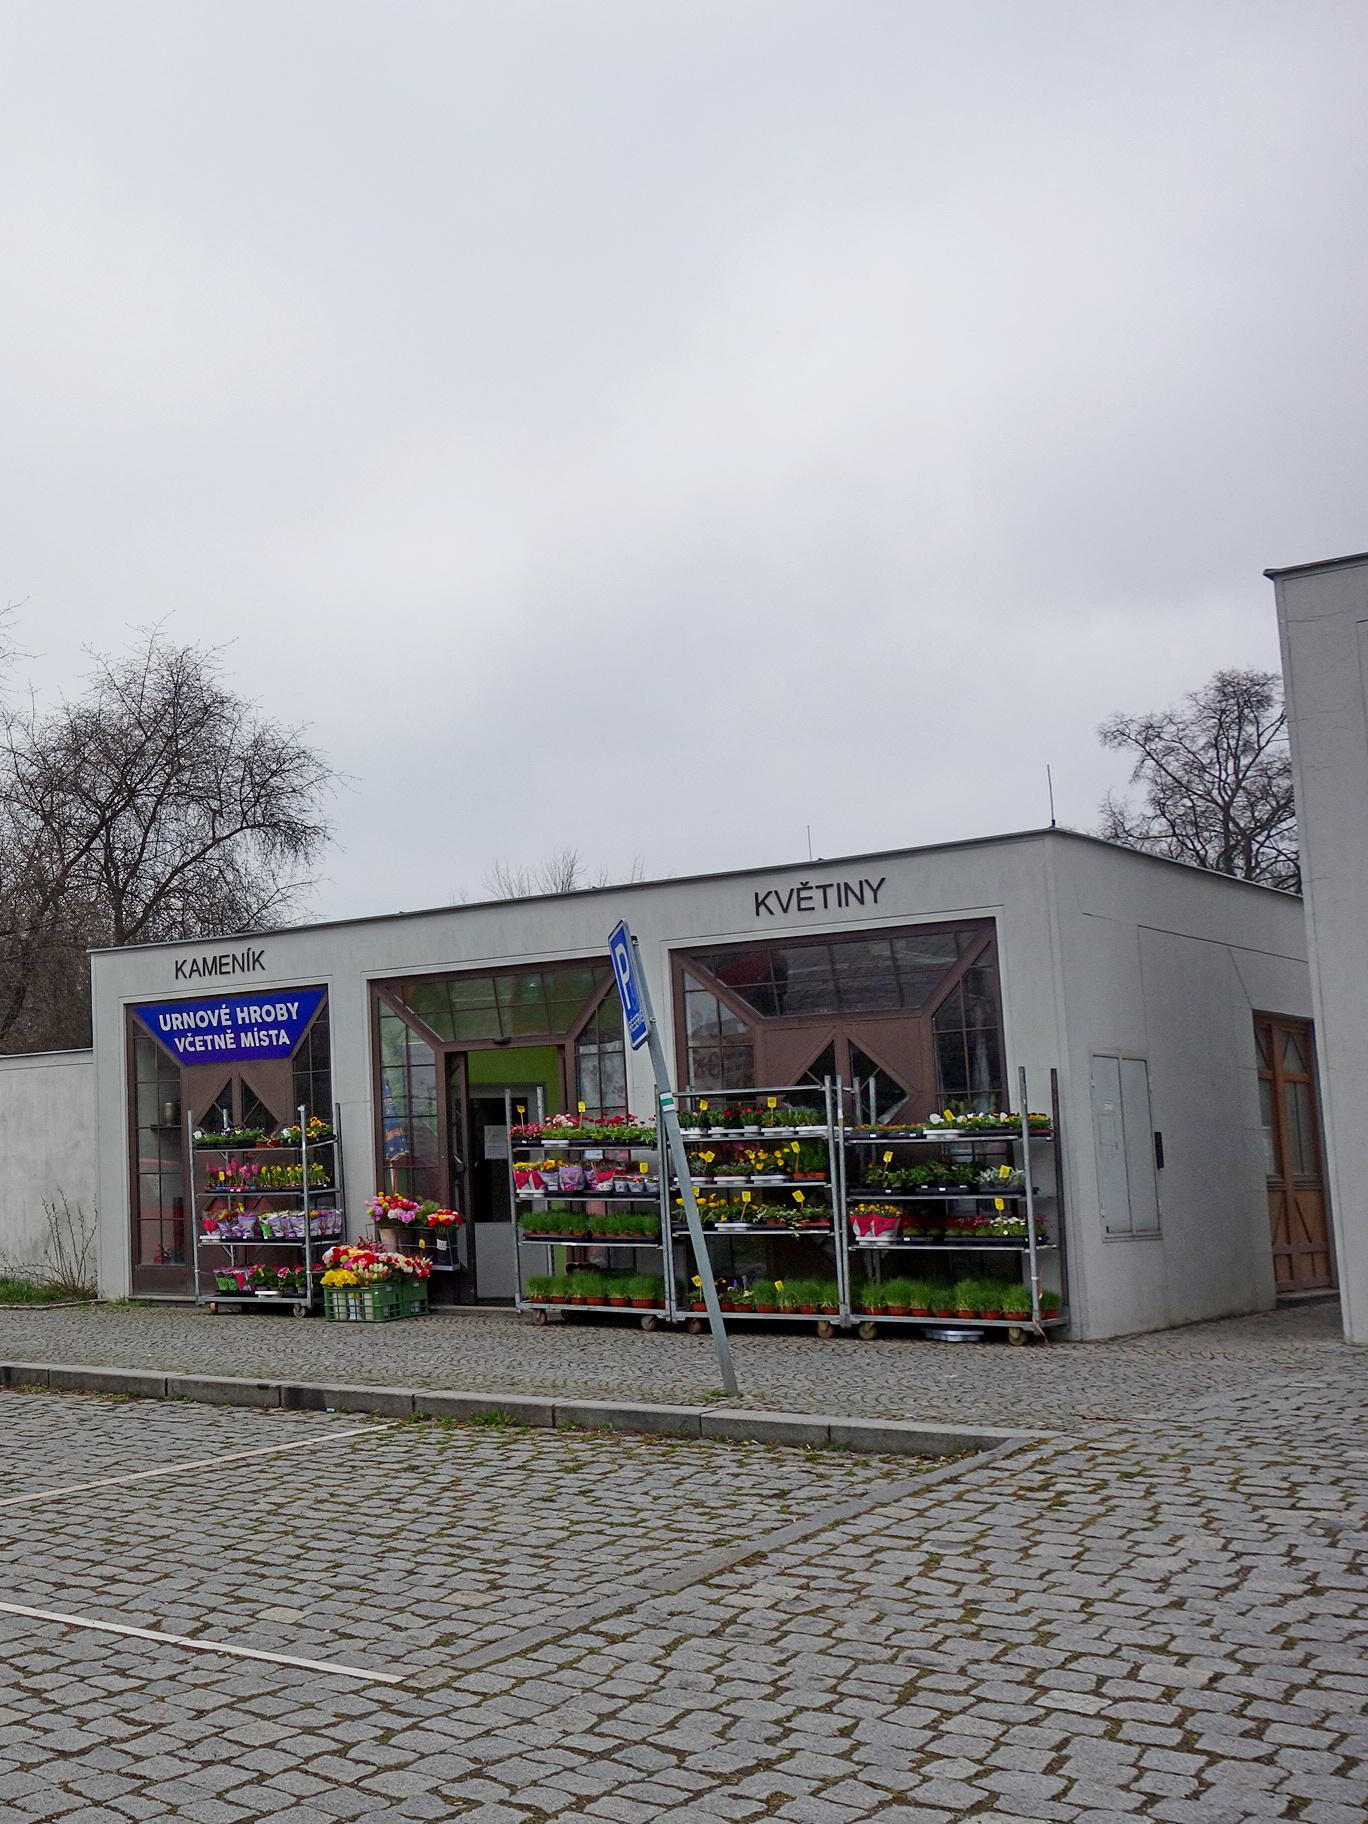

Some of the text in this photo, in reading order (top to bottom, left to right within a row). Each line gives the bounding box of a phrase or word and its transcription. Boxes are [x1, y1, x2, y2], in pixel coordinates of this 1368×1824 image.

[754, 877, 886, 916] KVĚTINY
[174, 947, 266, 980] KAMENÍK
[615, 943, 632, 1010] P
[158, 1002, 300, 1031] URNOVÉ HROBY
[174, 1027, 291, 1053] VČETNĚ MÍSTA
